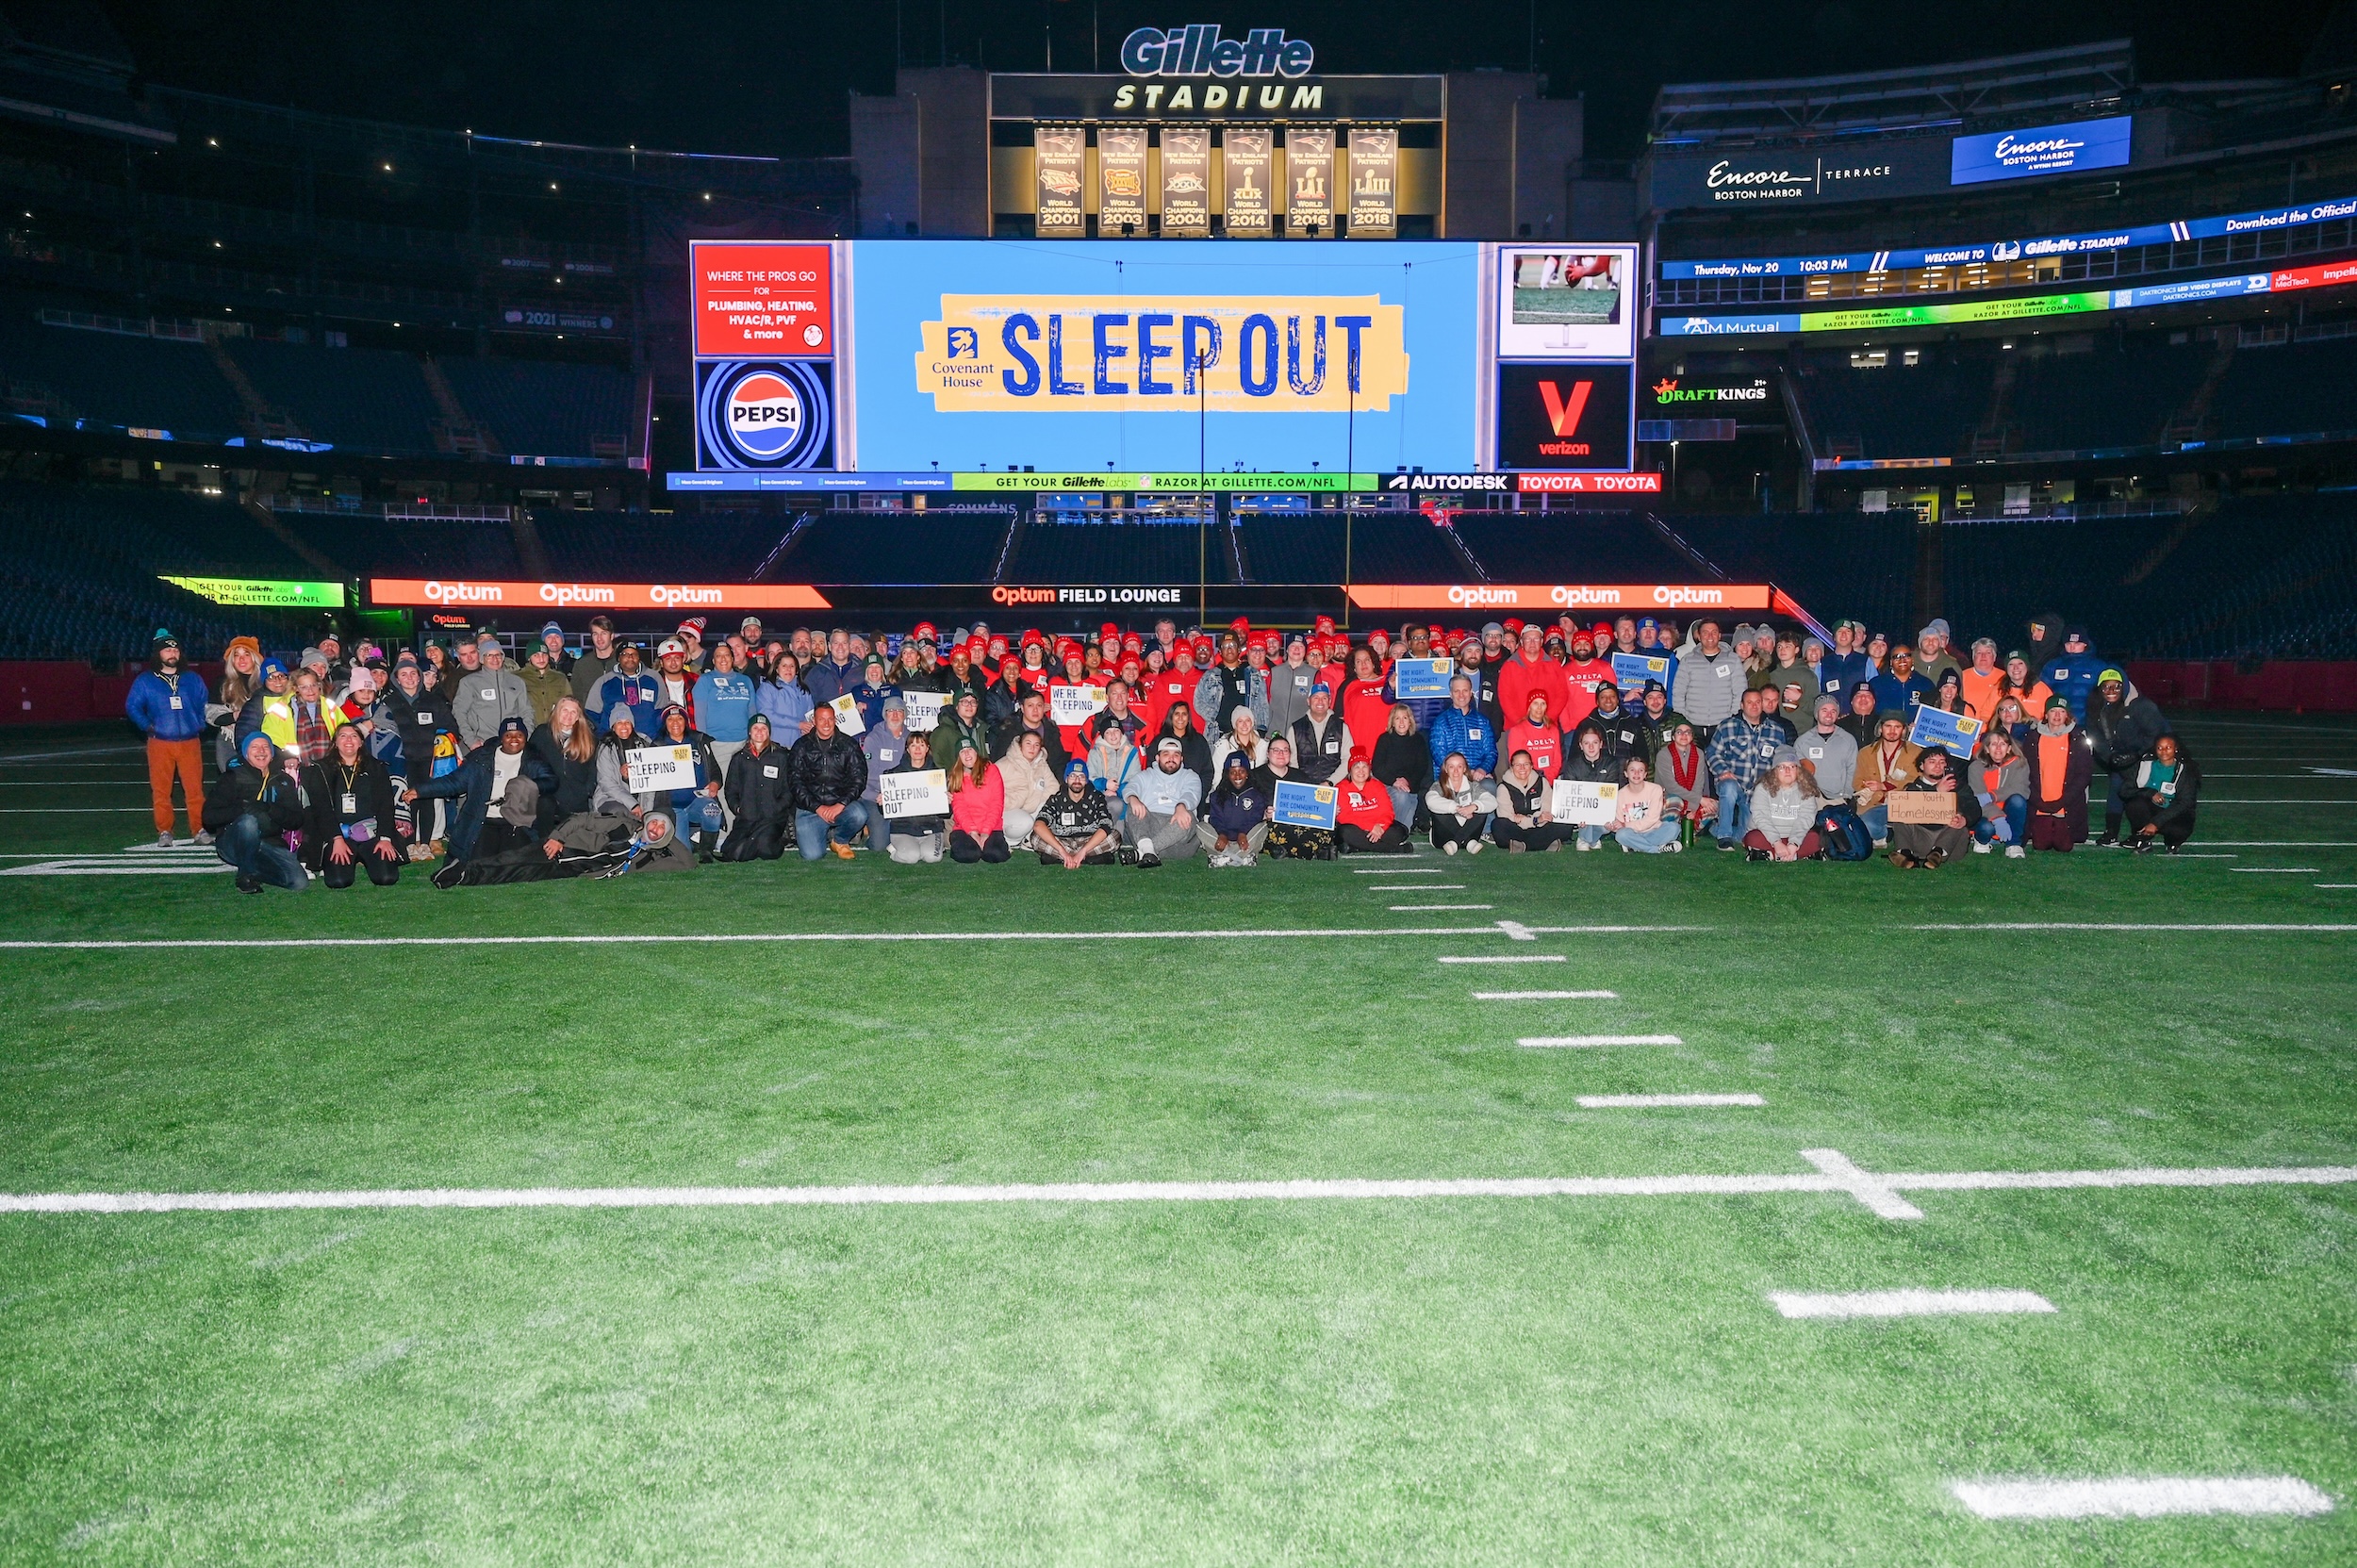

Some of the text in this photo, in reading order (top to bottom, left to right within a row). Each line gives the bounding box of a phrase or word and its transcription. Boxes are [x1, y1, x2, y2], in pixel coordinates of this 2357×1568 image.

[1121, 25, 1314, 78] Gillette
[1113, 84, 1323, 108] STADIUM
[1994, 135, 2085, 158] Encore
[2003, 151, 2075, 166] BOSTON HARBOR
[1706, 160, 1891, 189] Encore TERRACE
[1233, 191, 1262, 200] XLIX
[1715, 189, 1803, 201] BOSTON HARBOR
[1043, 215, 1079, 224] 2001
[1104, 215, 1143, 224] 2003
[1166, 215, 1205, 225] 2004
[1230, 215, 1265, 226] 2014
[1293, 215, 1327, 226] 2016
[1355, 214, 1390, 224] 2018
[1694, 202, 2356, 277] Thursday, Nov 20 10:03 PM WELCOME TO Gillette STADIUM Download the Official
[707, 272, 816, 281] WHERE THE PROS GO
[2275, 273, 2293, 282] J&J
[2275, 277, 2309, 288] MedTech
[2140, 287, 2176, 297] DAKTRONICS
[2212, 280, 2241, 289] DISPLAYS
[2163, 289, 2217, 301] DAKTRONICS.COM
[708, 301, 816, 312] PLUMBING, HEATING,
[526, 312, 555, 325] 2021
[729, 315, 797, 326] HVAC/R, PVF
[1726, 322, 1779, 333] Mutual
[743, 329, 783, 339] & more
[1001, 313, 1372, 396] SLEEP OUT
[931, 362, 994, 374] Covenant
[943, 376, 982, 388] House
[1656, 388, 1767, 404] DRAFTKINGS
[733, 406, 796, 422] PEPSI
[1539, 441, 1590, 455] verizon
[997, 477, 1335, 488] GET YOUR RAZOR AT GILLETTE.COM/NFL
[1410, 475, 1507, 490] AUTODESK
[1520, 475, 1656, 490] TOYOTA TOYOTA
[424, 581, 502, 604] Optum
[539, 584, 614, 607] Optum
[650, 585, 722, 607] Optum
[992, 586, 1180, 606] Optum FIELD LOUNGE
[1448, 586, 1517, 608] Optum
[1550, 586, 1621, 608] Optum
[1653, 586, 1722, 608] Optum
[233, 595, 320, 603] GILLETTE.COM/NFL
[433, 615, 467, 625] Optum
[1053, 689, 1078, 699] WE'RE
[628, 751, 642, 763] I'M
[631, 762, 676, 776] SLEEPING
[632, 777, 650, 789] OUT
[882, 777, 896, 788] I'M
[883, 787, 929, 801] SLEEPING
[1923, 793, 1944, 801] Youth
[885, 802, 902, 814] OUT
[1891, 804, 1954, 820] Homelessness
